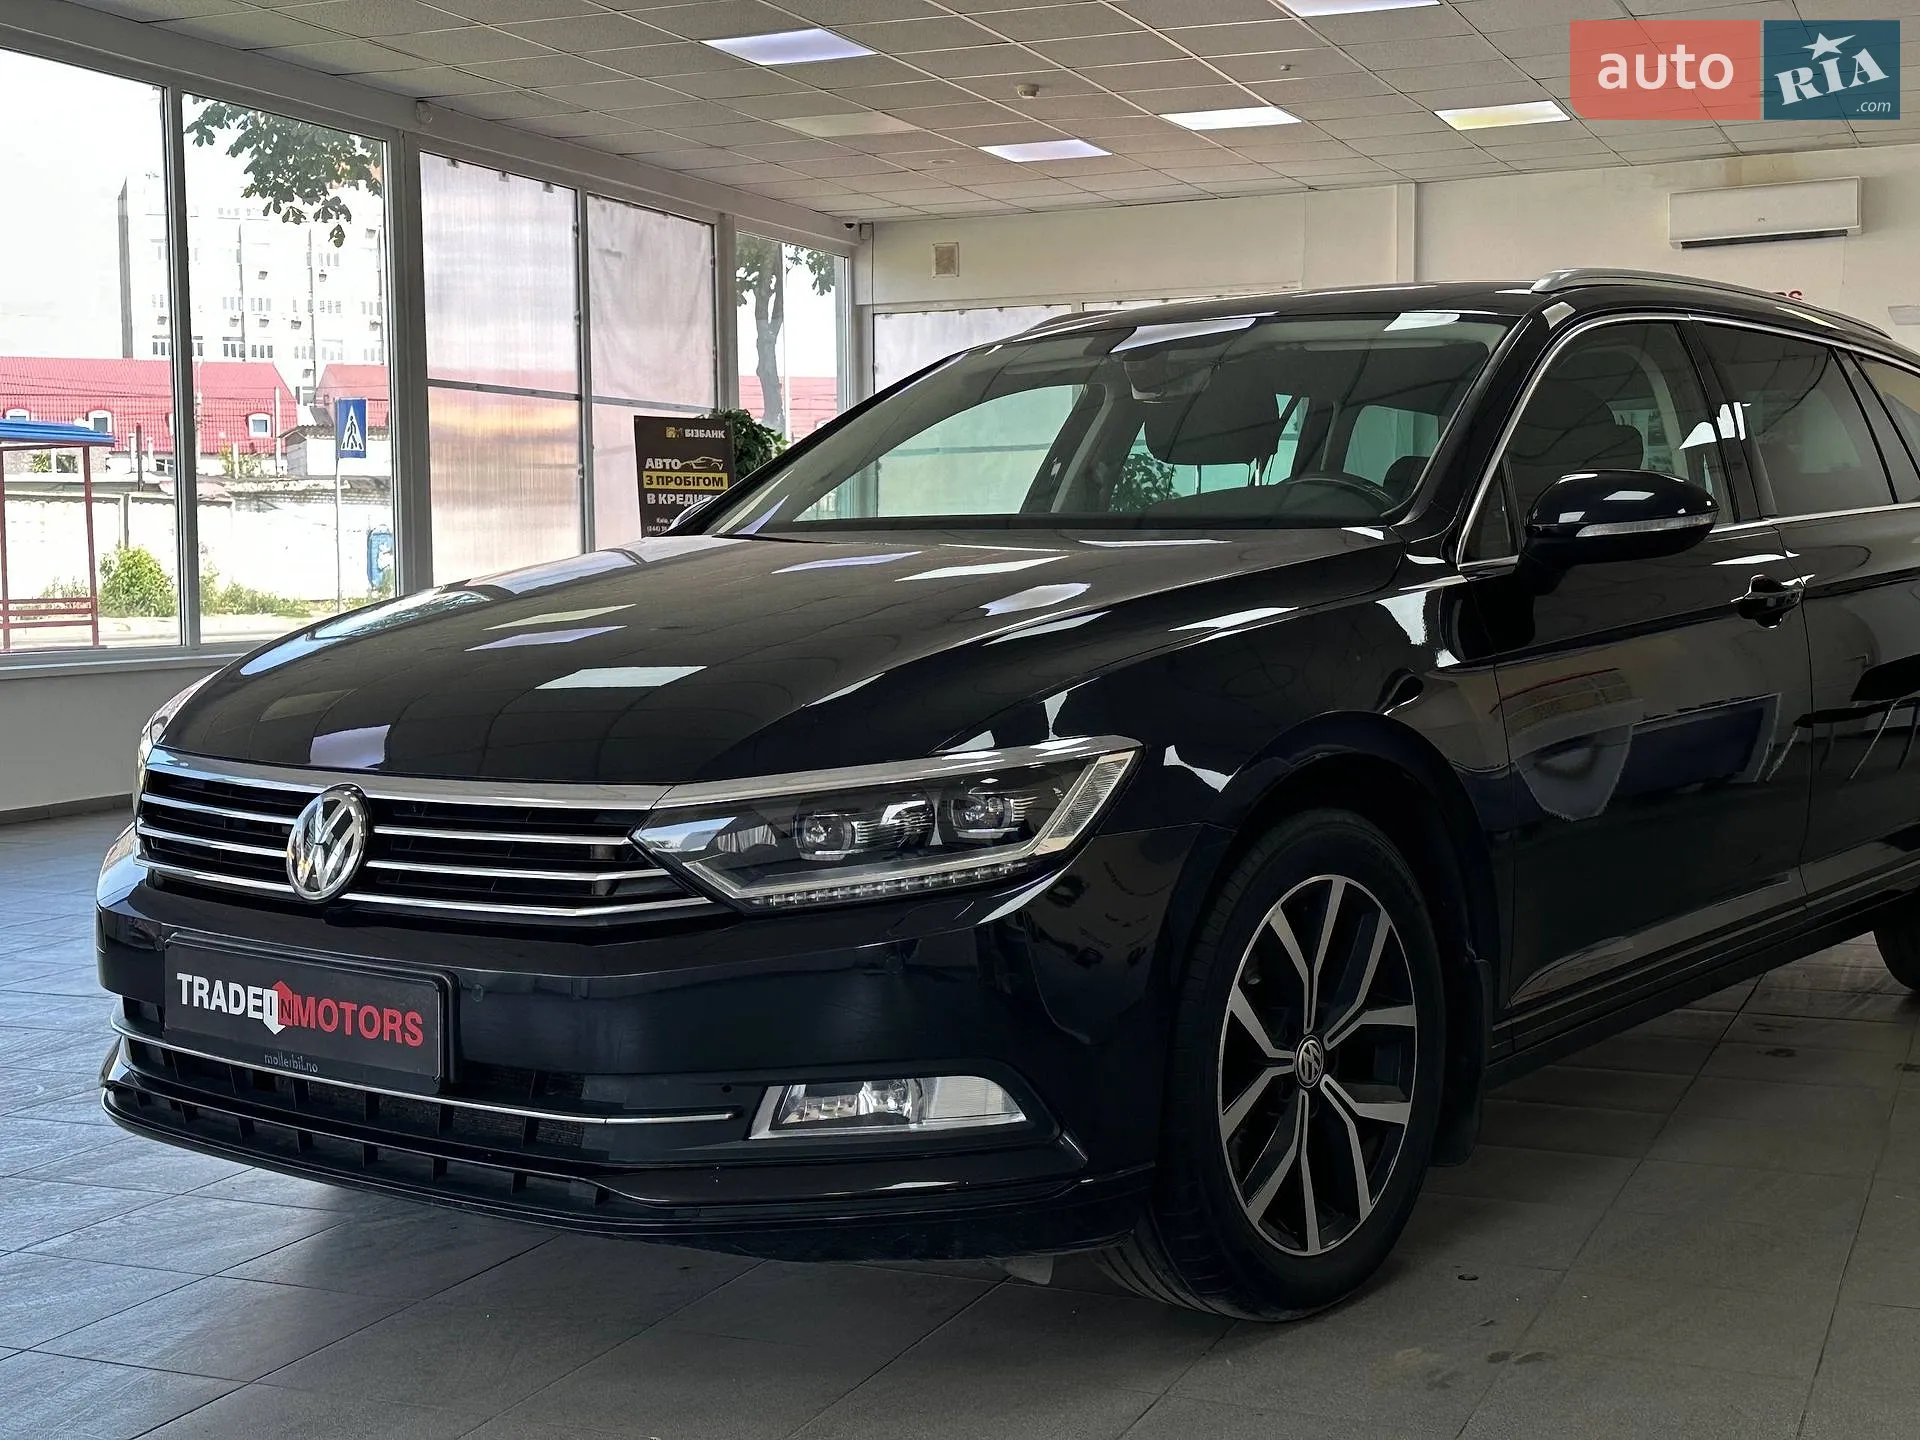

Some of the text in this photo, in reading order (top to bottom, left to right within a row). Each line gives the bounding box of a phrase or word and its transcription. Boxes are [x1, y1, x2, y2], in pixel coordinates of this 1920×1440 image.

[684, 428, 726, 439] БІЗБАНК
[645, 458, 682, 470] АВТО
[646, 476, 724, 487] З ПРОБІГОМ
[646, 493, 656, 505] В
